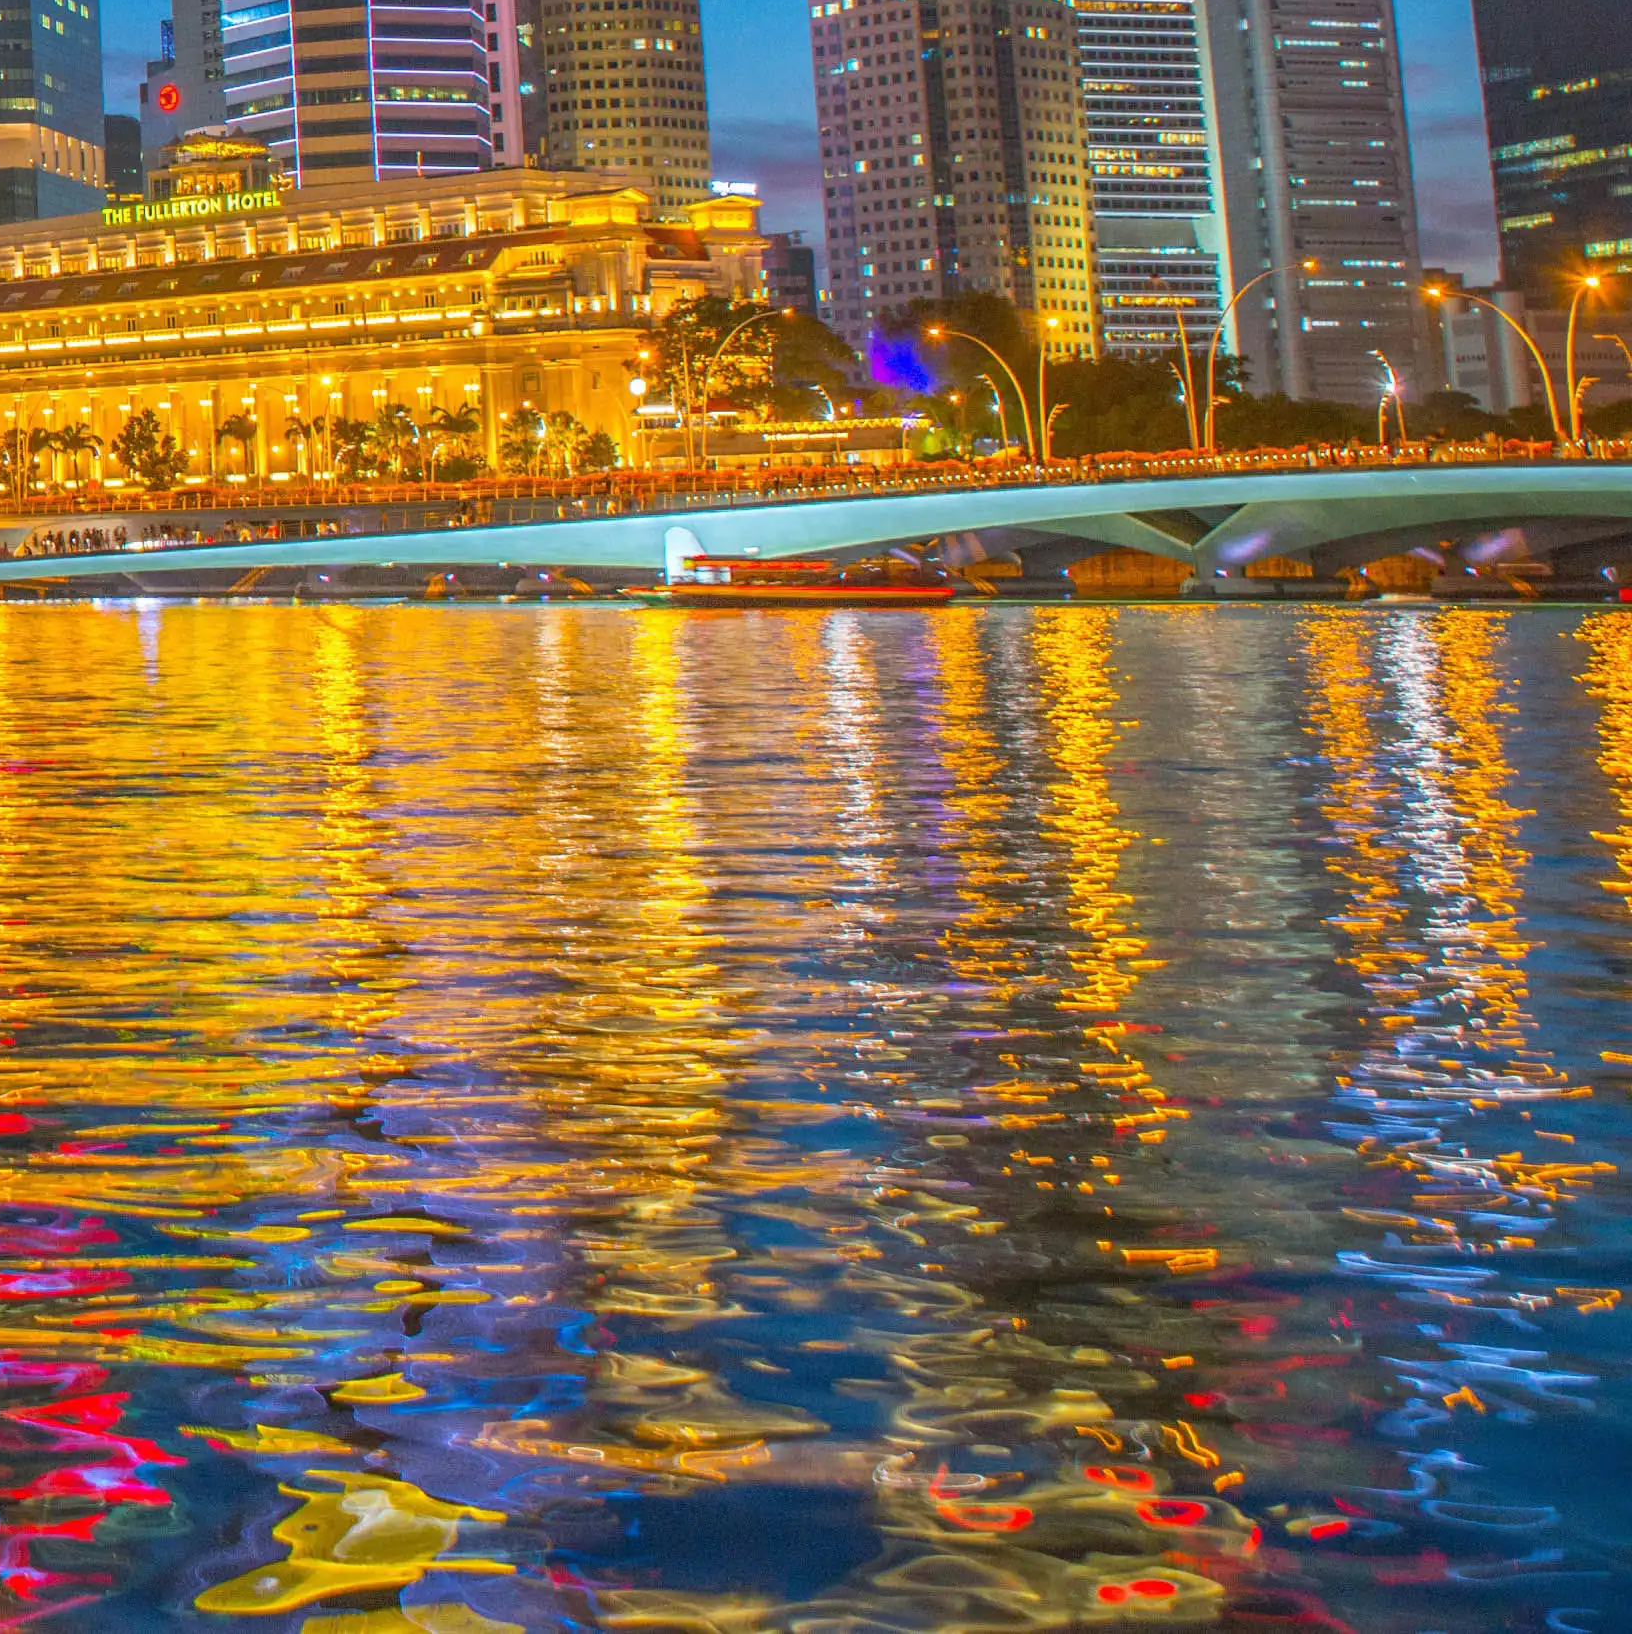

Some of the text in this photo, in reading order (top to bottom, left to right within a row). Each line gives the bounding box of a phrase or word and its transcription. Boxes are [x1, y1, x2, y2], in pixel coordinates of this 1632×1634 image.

[101, 191, 281, 225] THE FULLERTON HOTEL
